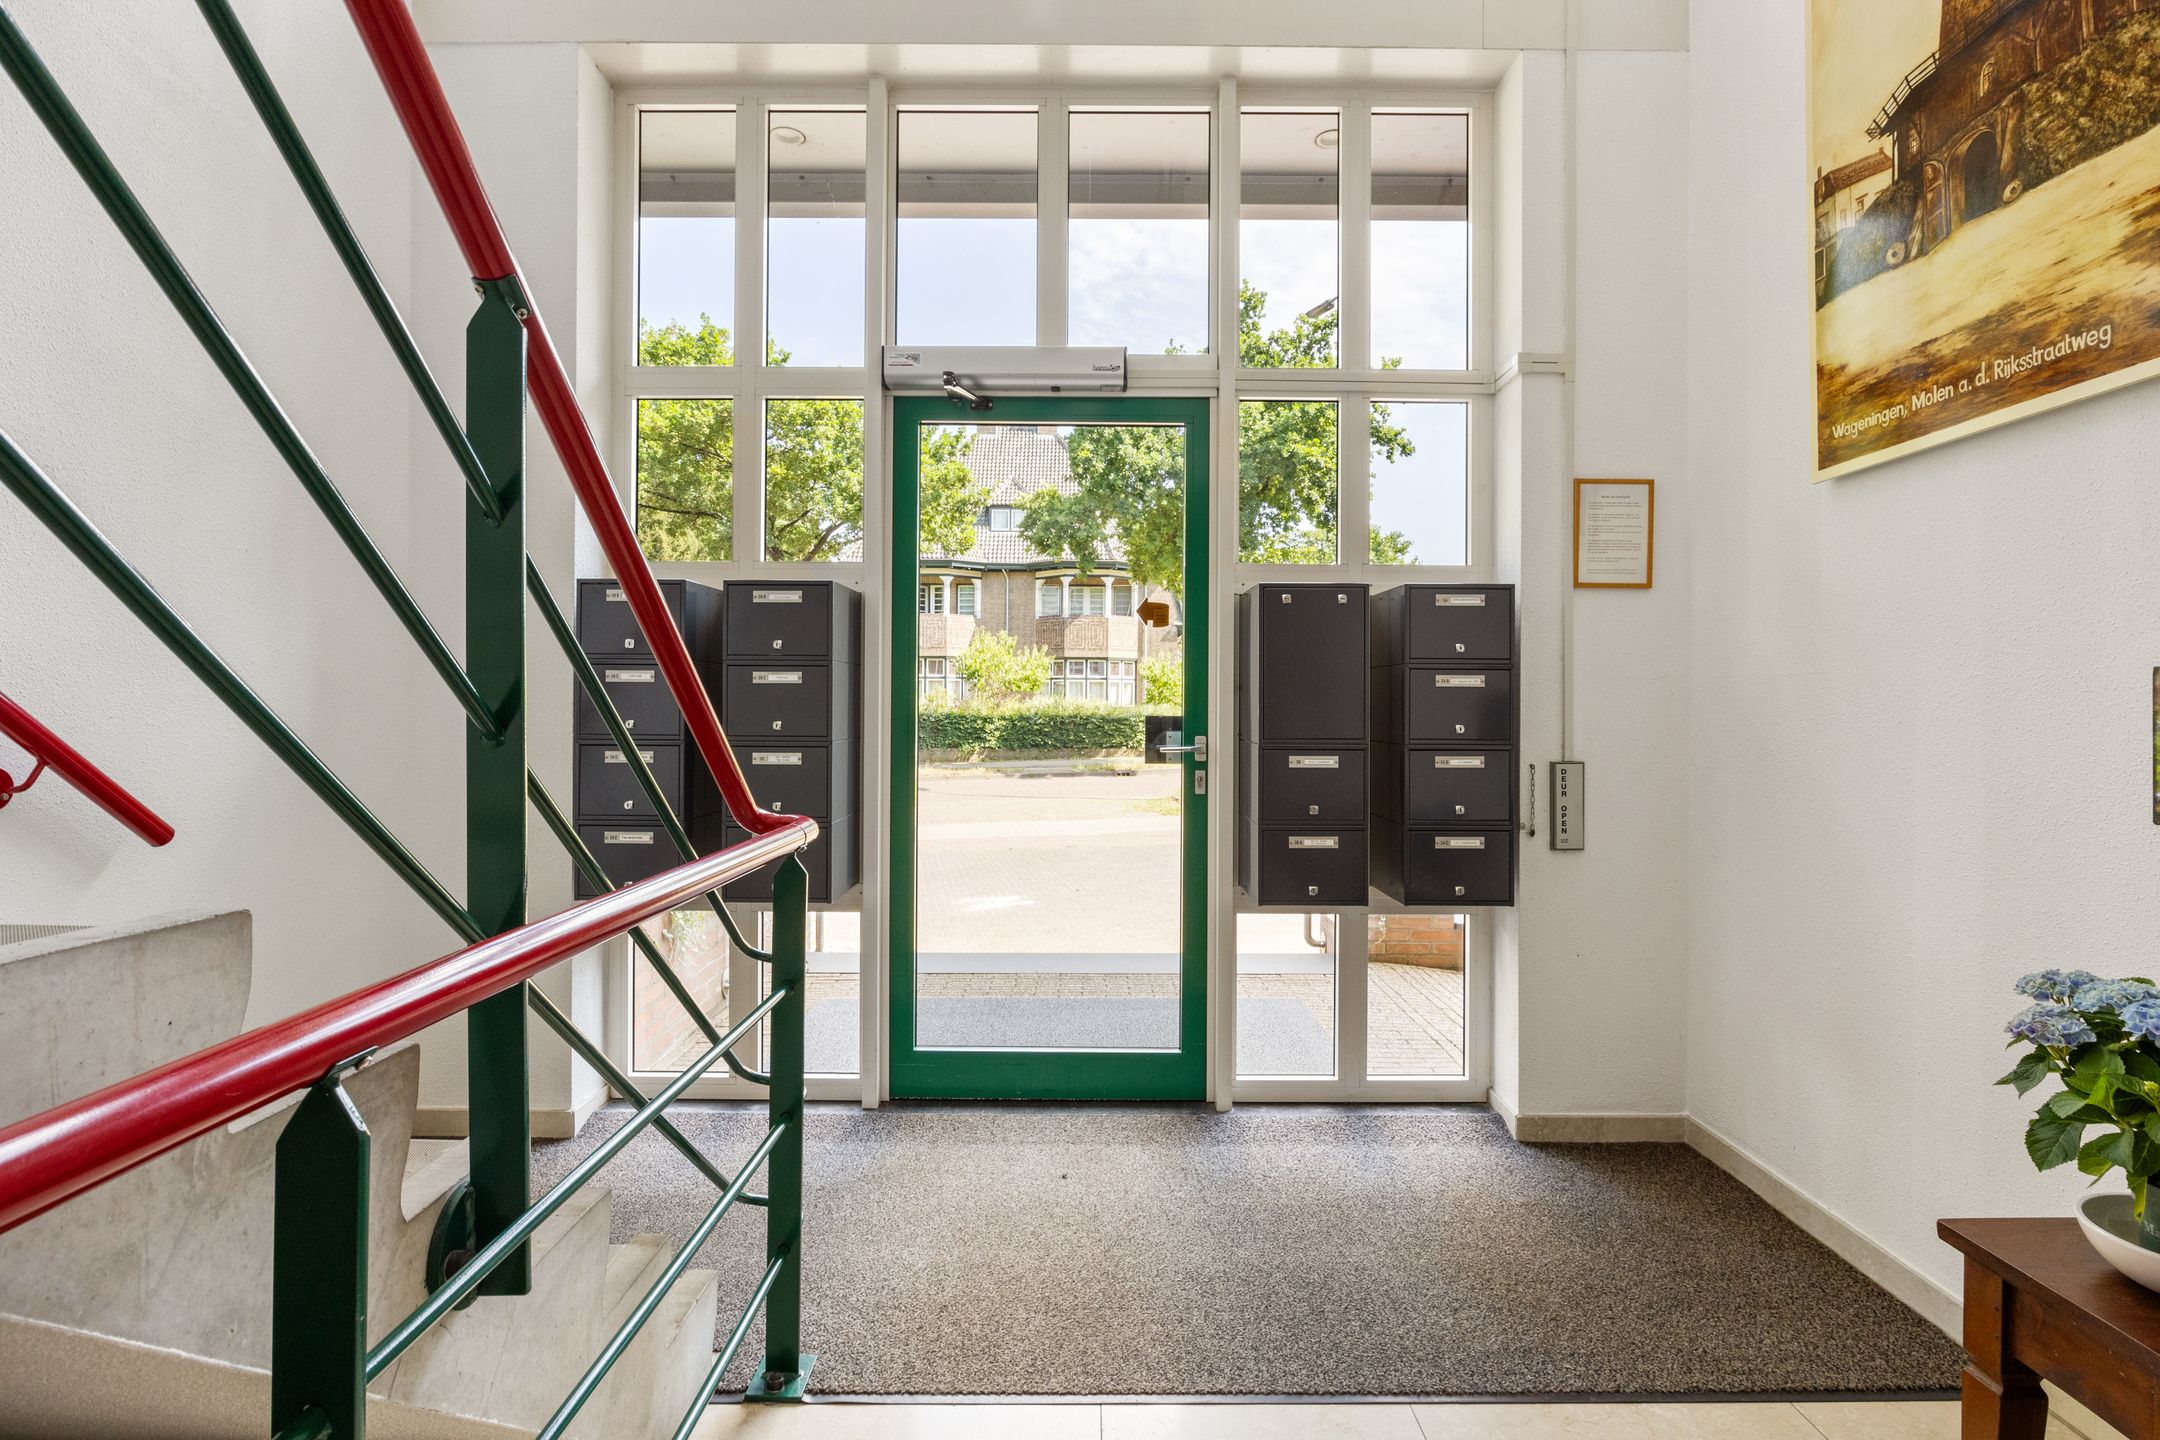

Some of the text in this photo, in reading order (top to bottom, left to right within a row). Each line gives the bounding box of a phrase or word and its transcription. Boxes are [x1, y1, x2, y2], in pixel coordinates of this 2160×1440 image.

[1832, 324, 2110, 438] Wageningen, Molen a. d. Rijksstraatweg
